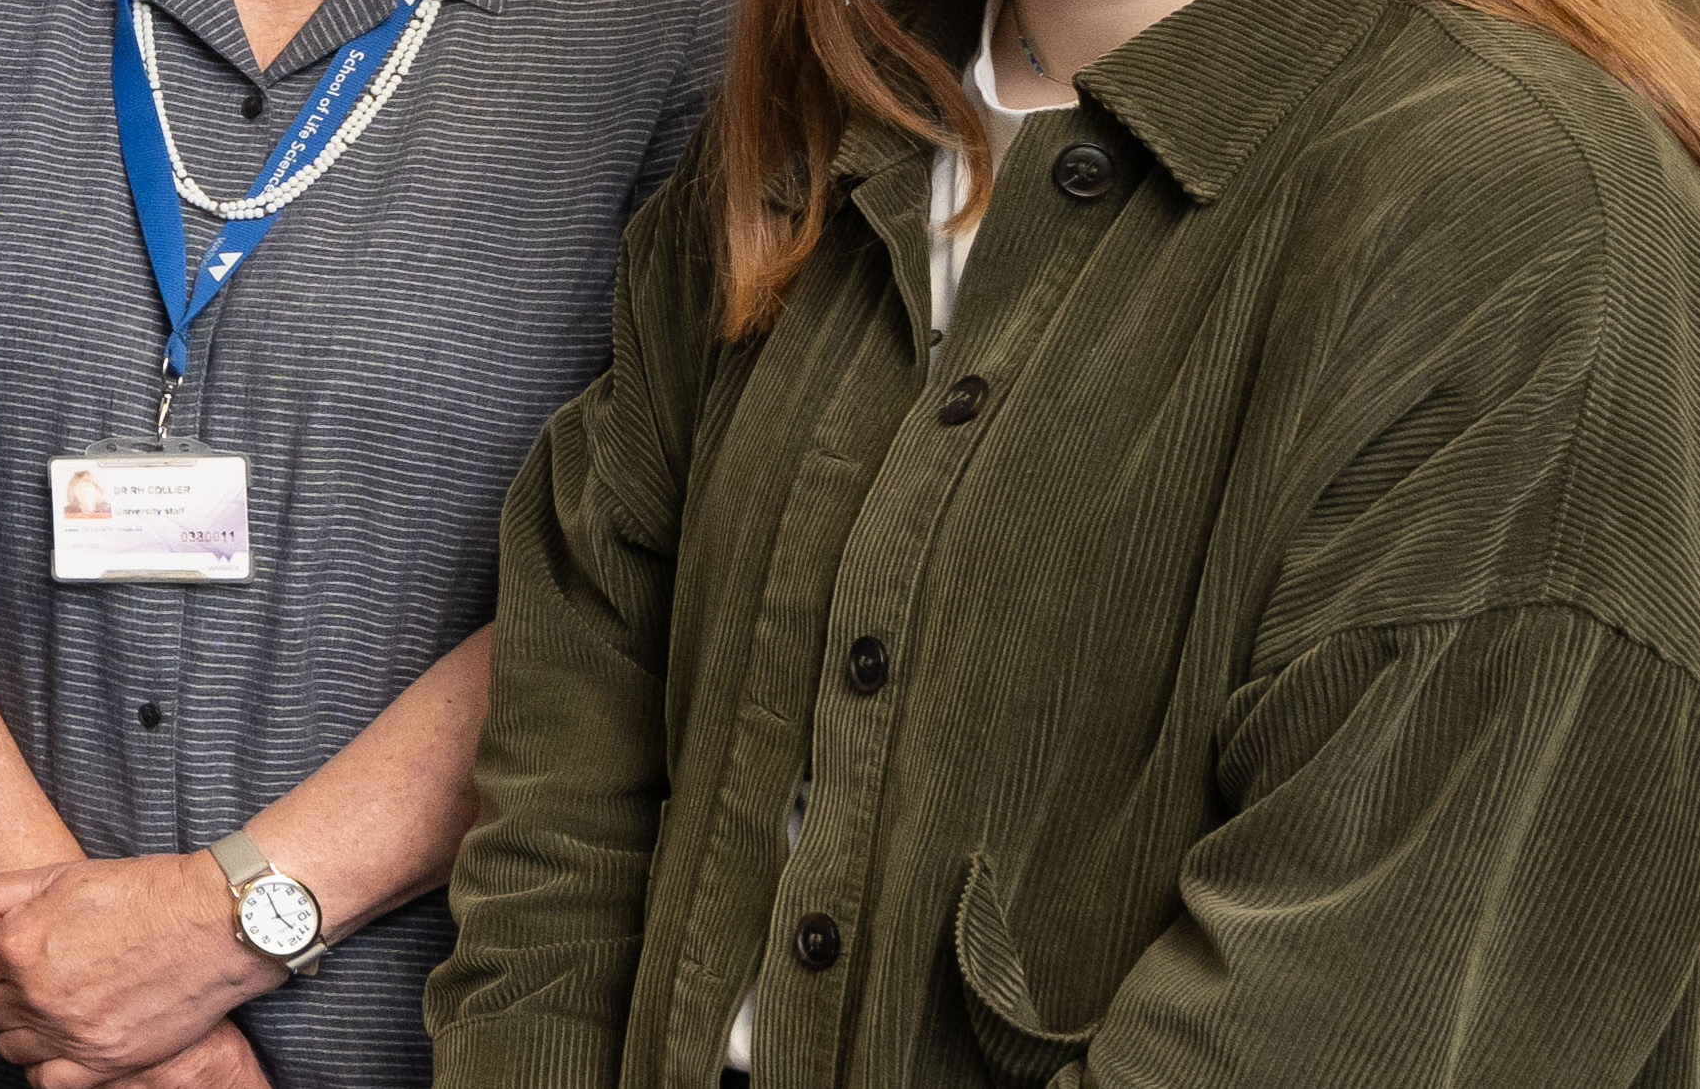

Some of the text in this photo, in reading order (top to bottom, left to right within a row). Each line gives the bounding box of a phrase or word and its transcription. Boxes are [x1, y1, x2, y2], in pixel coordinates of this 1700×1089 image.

[326, 49, 365, 97] School
[316, 97, 330, 115] of
[299, 114, 324, 139] Life
